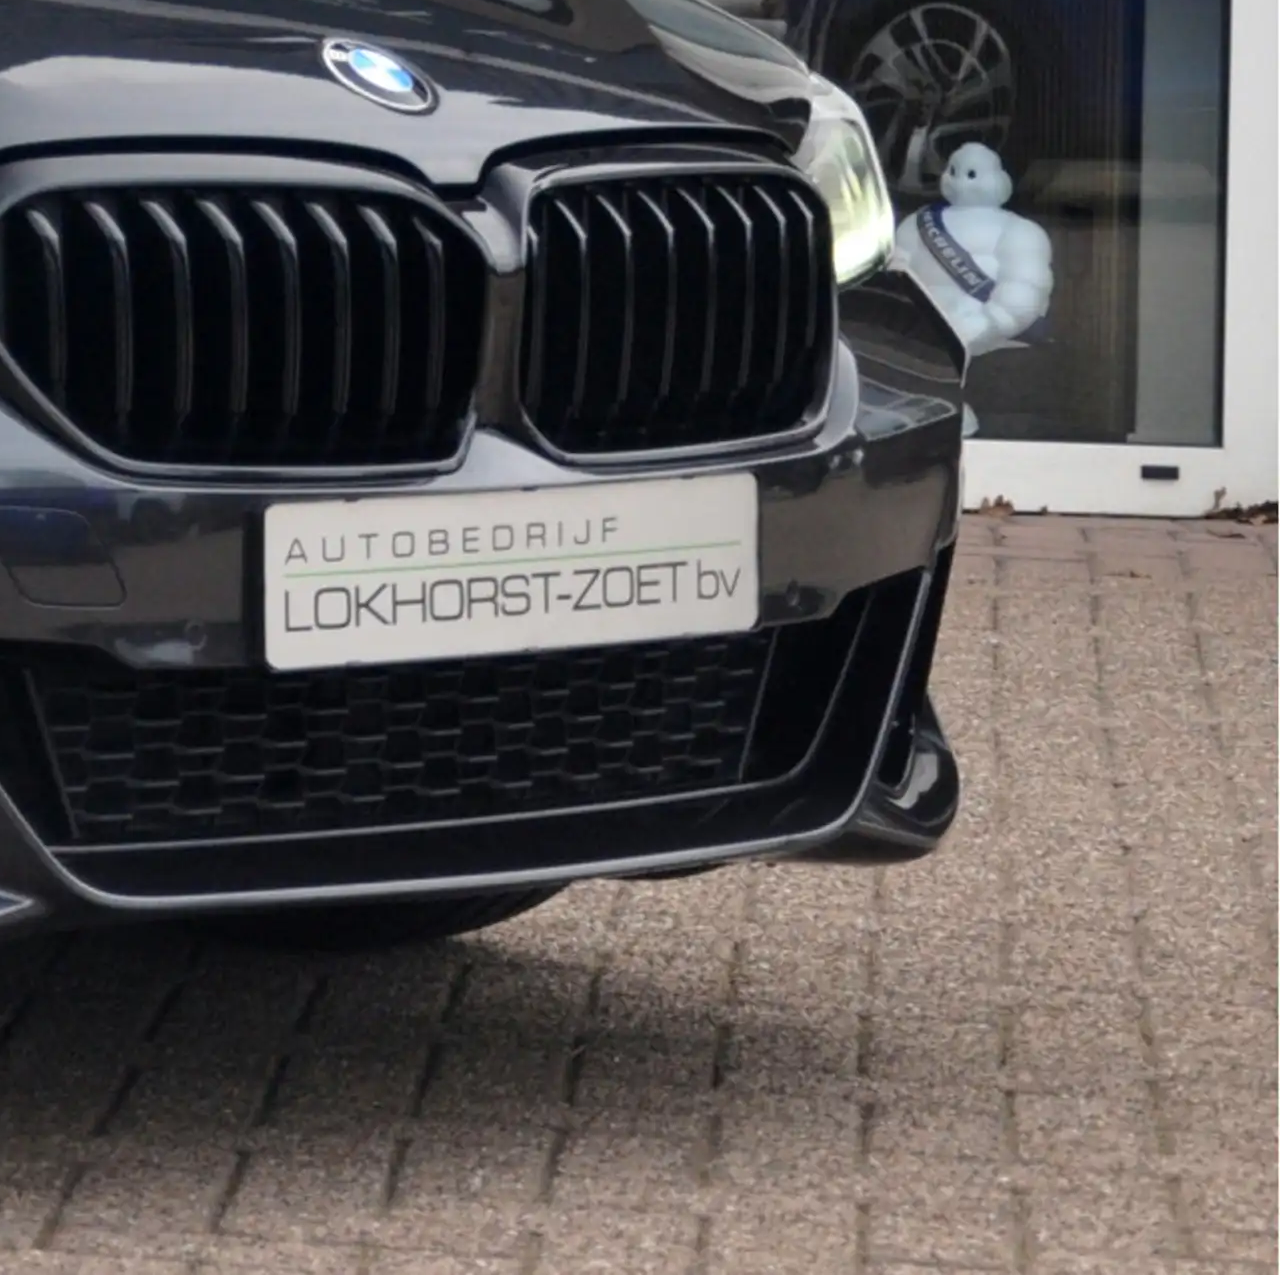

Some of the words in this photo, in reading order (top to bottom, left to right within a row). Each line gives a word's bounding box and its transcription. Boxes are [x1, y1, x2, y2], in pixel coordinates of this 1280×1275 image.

[285, 516, 620, 564] AUTOBEDRIJF
[284, 561, 688, 633] LOKHORST-ZOET
[696, 559, 741, 601] bv
